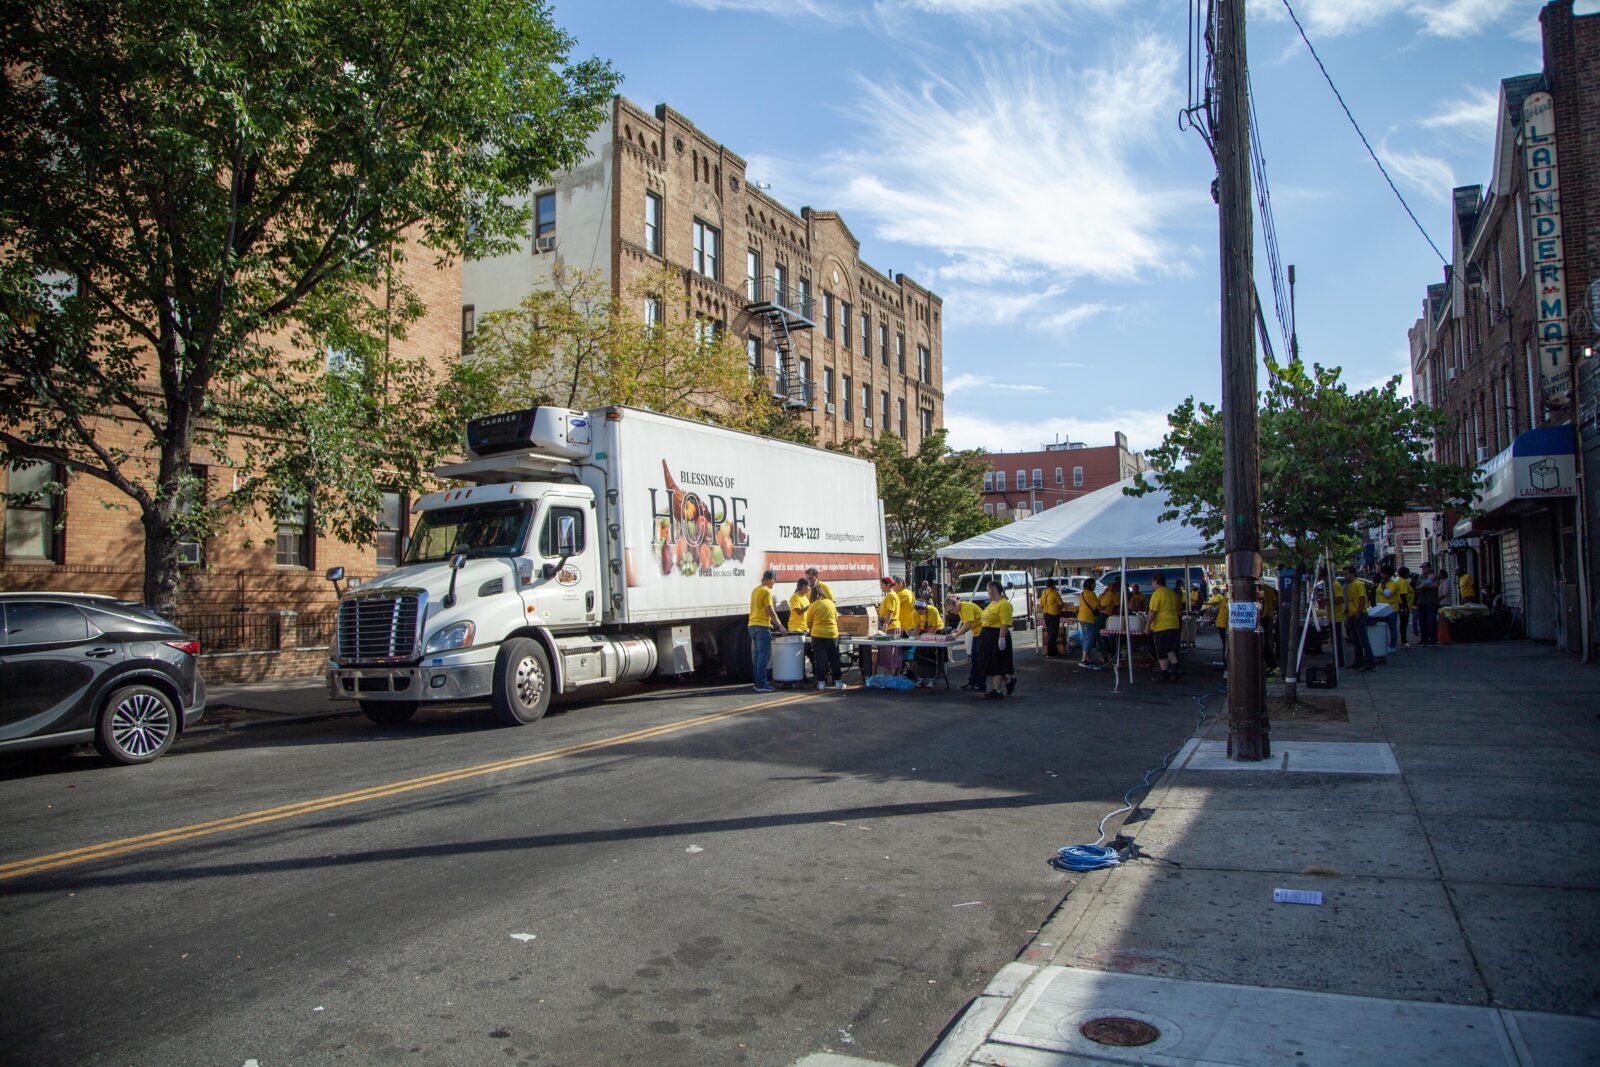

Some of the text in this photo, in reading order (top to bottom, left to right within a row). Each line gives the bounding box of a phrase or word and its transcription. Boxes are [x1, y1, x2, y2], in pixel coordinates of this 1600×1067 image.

[481, 415, 517, 426] CARRIER
[680, 471, 735, 489] BLESSINGS OF
[1520, 486, 1572, 497] LAUNDROMAT
[648, 488, 750, 547] HOPE
[779, 525, 820, 540] 717-824-1227
[712, 568, 733, 577] because
[770, 563, 781, 571] Food
[820, 564, 829, 572] you
[1284, 577, 1292, 588] P
